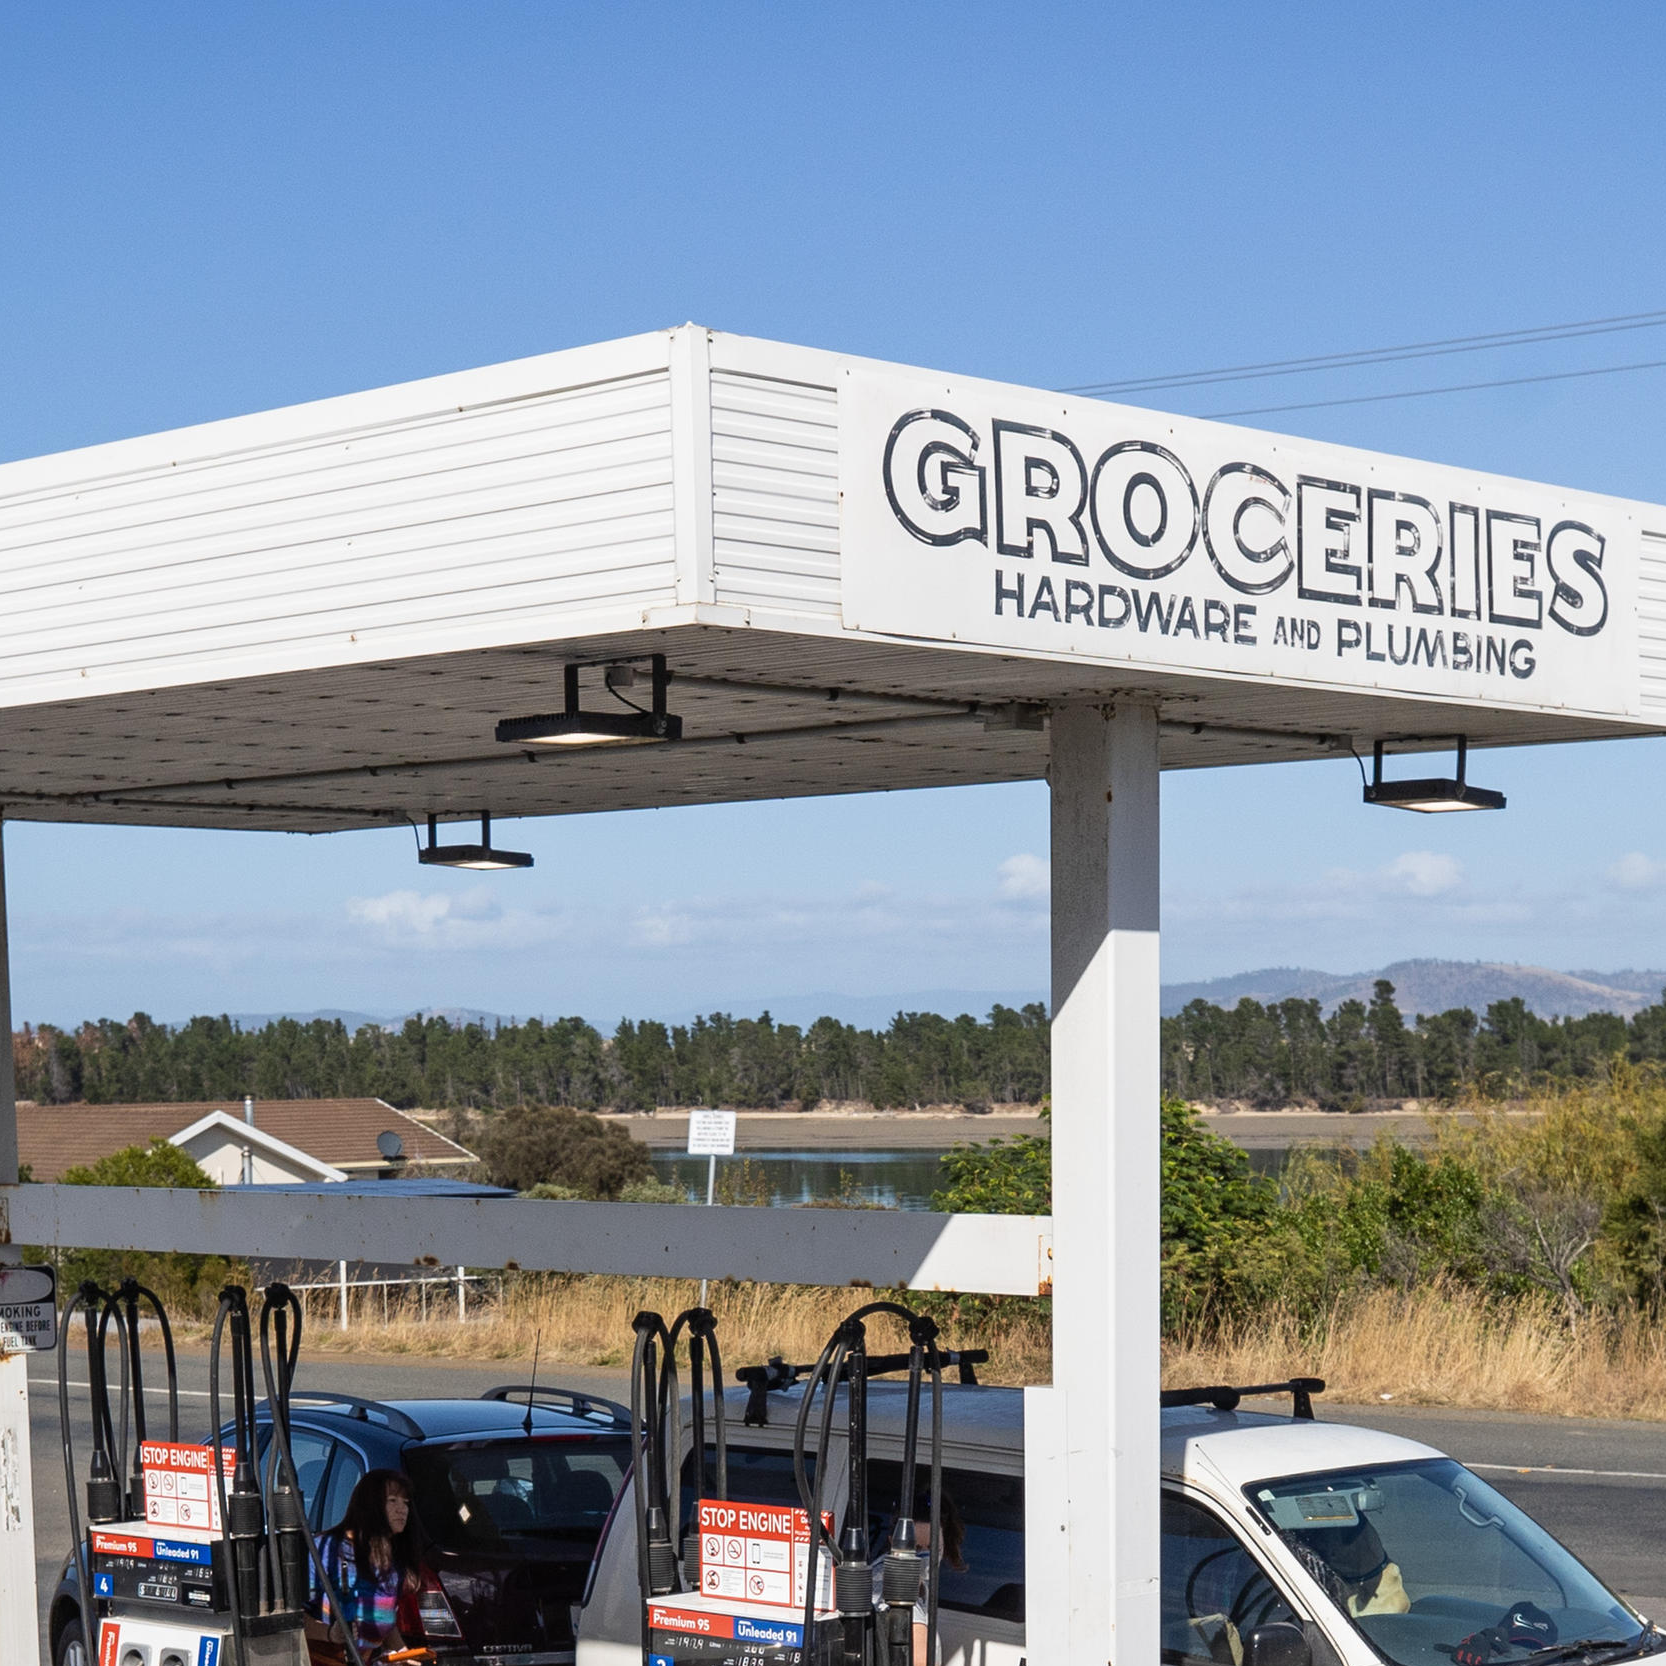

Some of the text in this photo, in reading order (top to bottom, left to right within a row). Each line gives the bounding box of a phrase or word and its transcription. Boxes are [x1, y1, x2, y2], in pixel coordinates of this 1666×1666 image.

[882, 407, 1609, 637] GROCERIES
[994, 568, 1537, 680] HARDWARE AND PLUMBING
[0, 1320, 24, 1334] ENGINE
[26, 1319, 51, 1332] BEFORE
[3, 1337, 19, 1348] FUEL
[20, 1335, 38, 1347] TANK
[143, 1446, 169, 1465] STOP
[170, 1449, 208, 1469] ENGINE
[701, 1506, 736, 1528] STOP
[739, 1510, 791, 1535] ENGINE
[96, 1539, 138, 1553] Premium 95
[156, 1545, 199, 1560] Unleaded 91
[100, 1577, 109, 1593] 4
[653, 1612, 710, 1631] Premium 95
[737, 1624, 797, 1643] Unleaded 91
